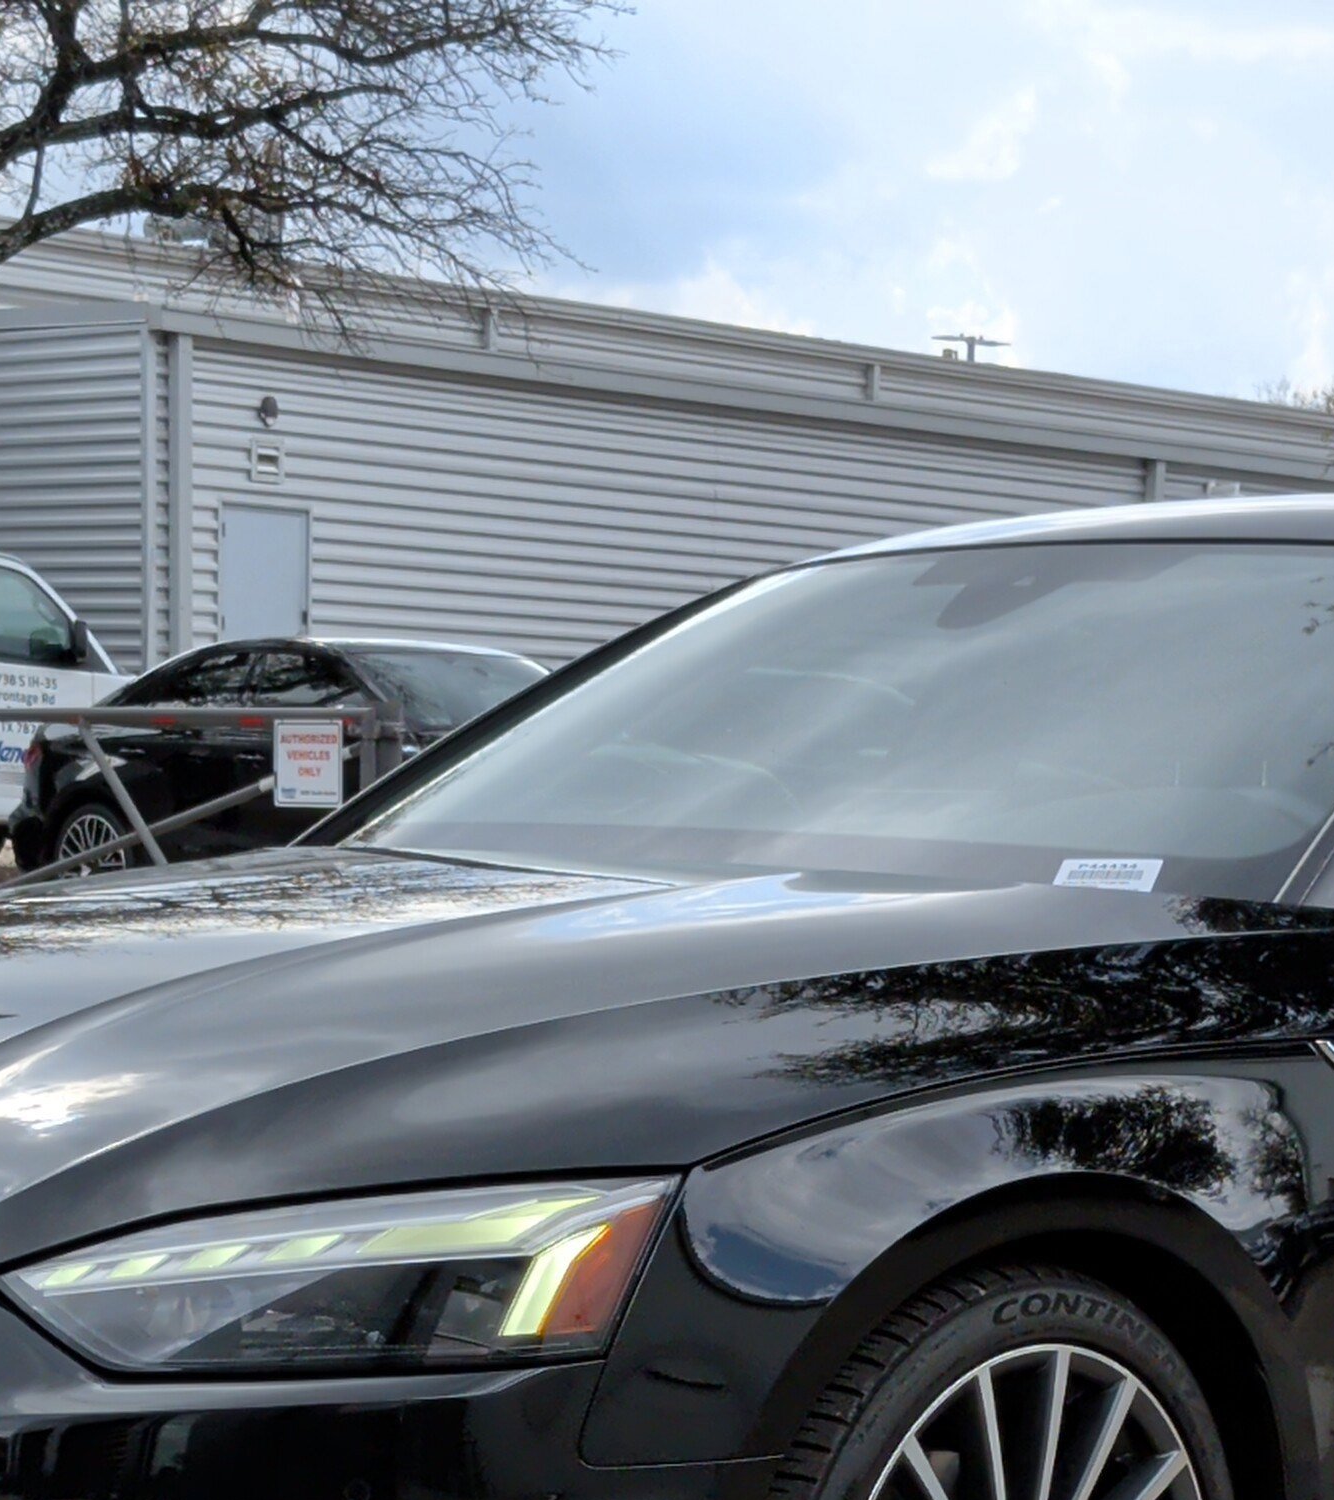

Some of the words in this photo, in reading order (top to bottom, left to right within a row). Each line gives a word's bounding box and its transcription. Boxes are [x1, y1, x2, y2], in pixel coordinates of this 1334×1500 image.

[18, 675, 25, 687] S
[28, 676, 58, 690] IH-35
[42, 692, 56, 705] Rd
[280, 733, 338, 745] AUTHORIZED
[287, 750, 331, 761] VEHICLES
[298, 767, 321, 777] ONLY
